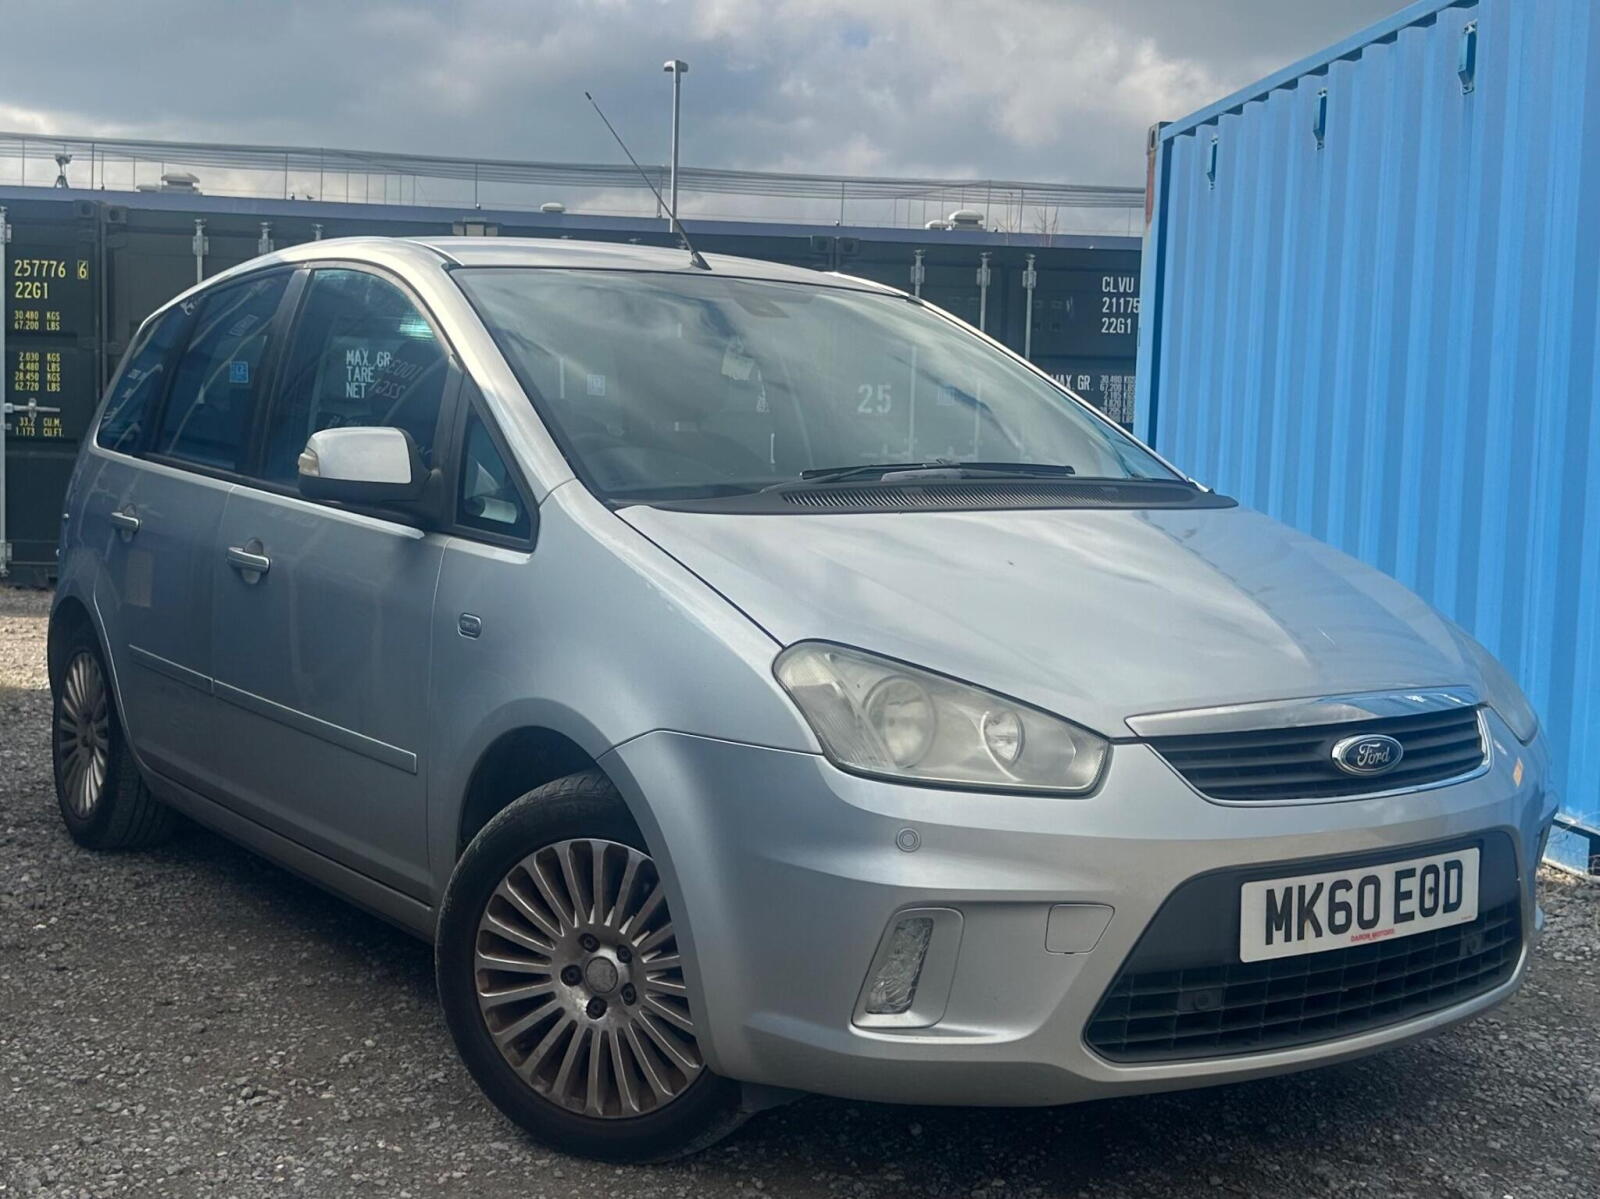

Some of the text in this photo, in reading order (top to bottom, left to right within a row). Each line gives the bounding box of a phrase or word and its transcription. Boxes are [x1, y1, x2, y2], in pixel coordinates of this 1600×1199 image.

[14, 259, 88, 279] 257776 6
[14, 282, 49, 299] 22G1
[1102, 276, 1134, 293] CLVU
[1102, 297, 1140, 314] 21175
[46, 311, 60, 320] KGS
[46, 321, 60, 331] LBS
[1101, 317, 1132, 334] 22G1
[46, 353, 60, 362] KGS
[46, 362, 60, 372] LBS
[346, 366, 375, 383] TARE
[46, 372, 60, 382] KGS
[46, 382, 60, 392] LBS
[346, 382, 366, 399] NET
[857, 383, 892, 413] 25
[1356, 742, 1390, 767] Ford
[1265, 874, 1382, 946] MK60
